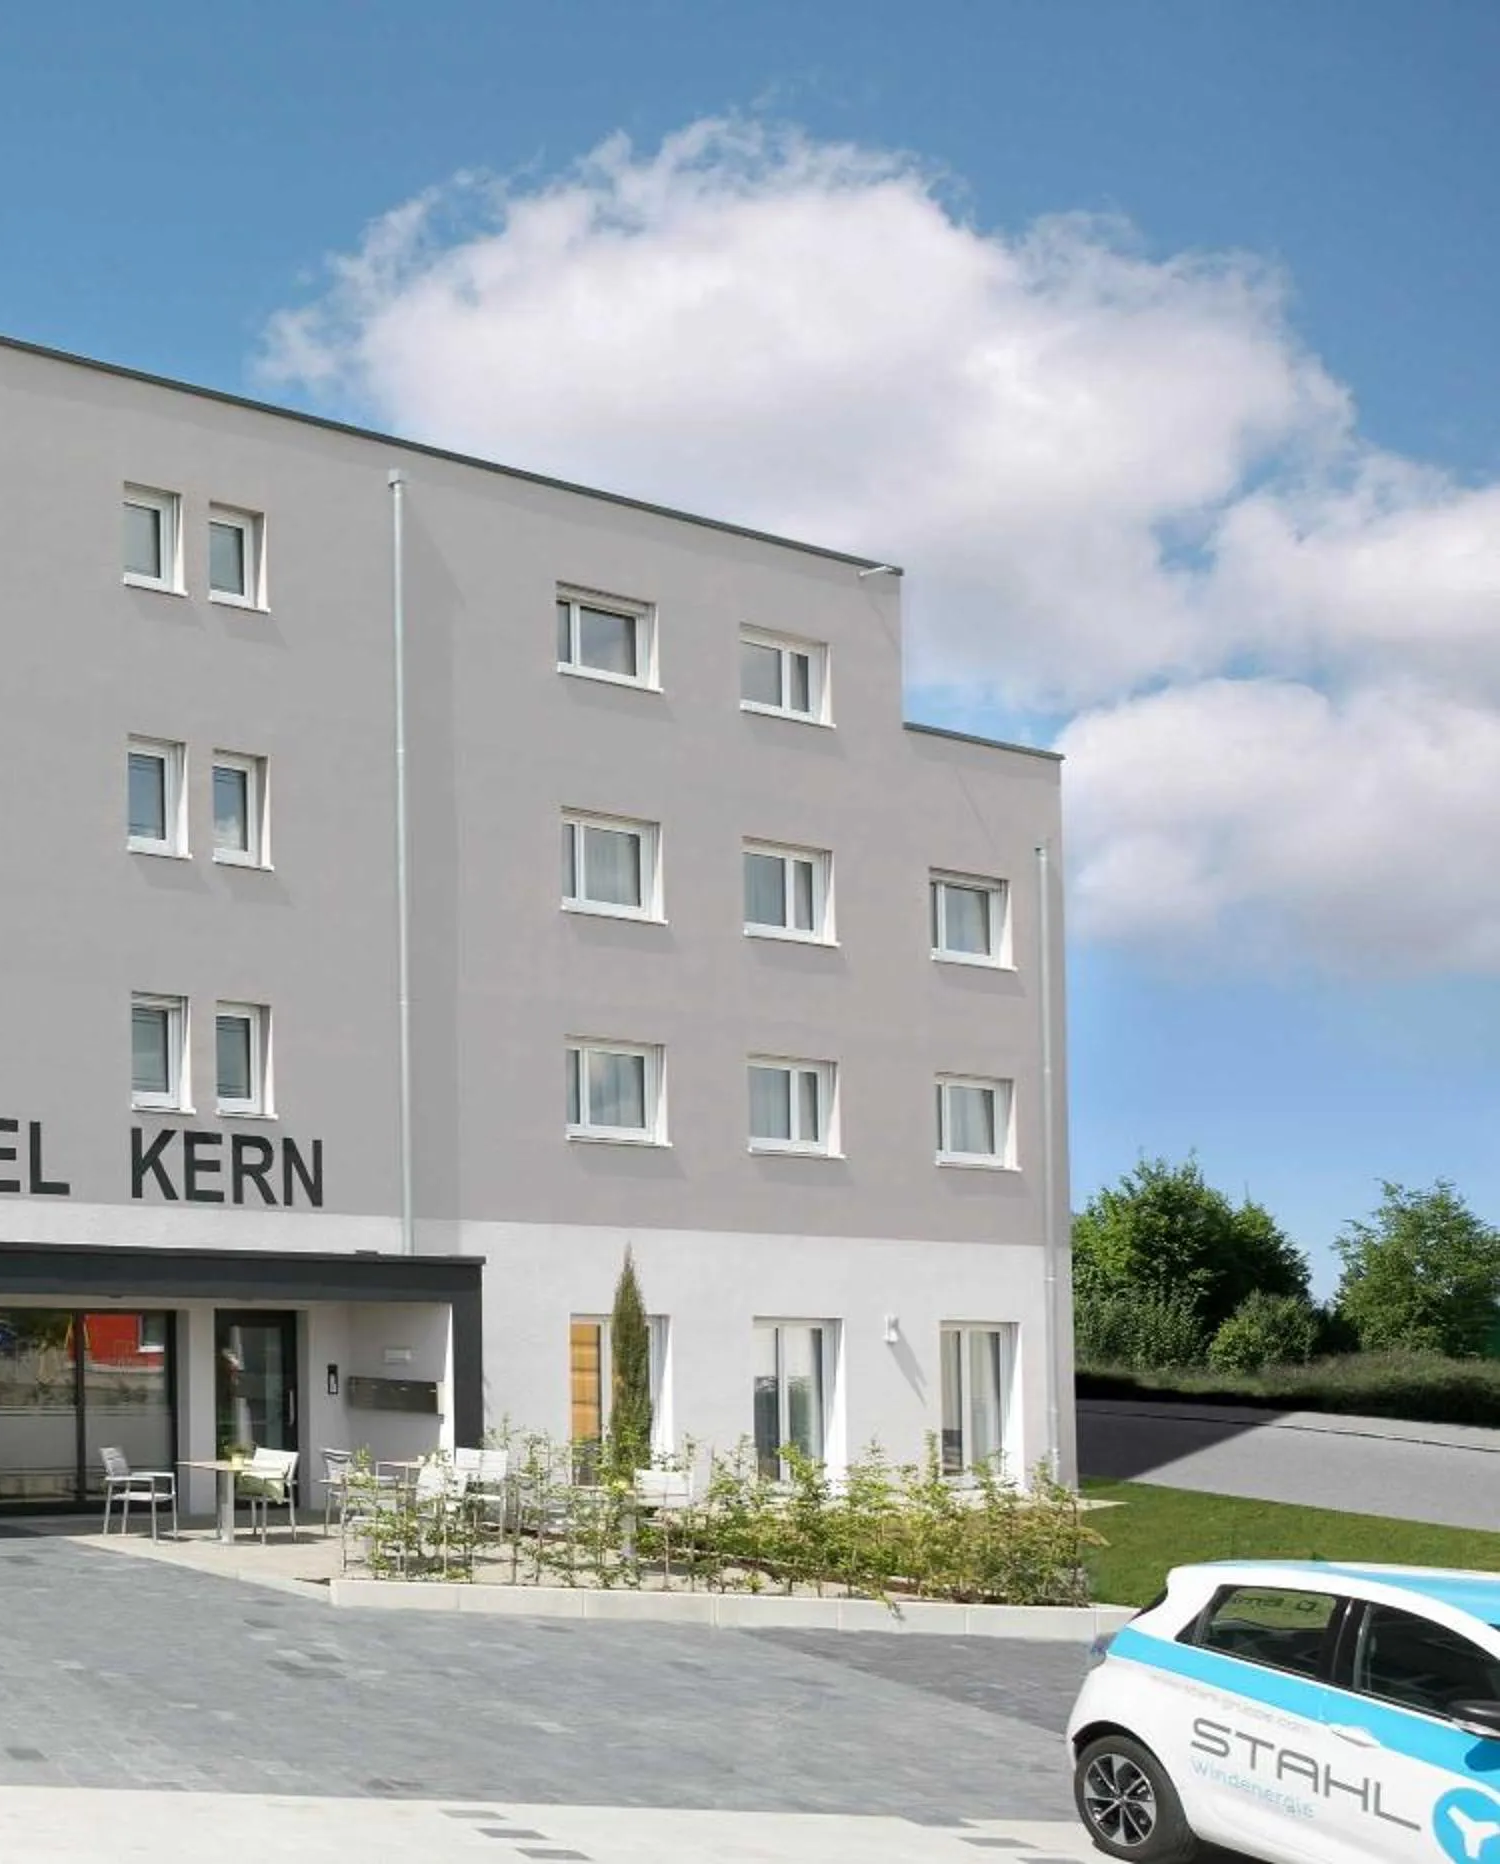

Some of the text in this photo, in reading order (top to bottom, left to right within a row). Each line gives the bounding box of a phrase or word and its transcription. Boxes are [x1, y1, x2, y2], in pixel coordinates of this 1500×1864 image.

[131, 1127, 323, 1207] KERN
[1189, 1755, 1315, 1819] Windenergie
[1190, 1717, 1422, 1832] STAHL
